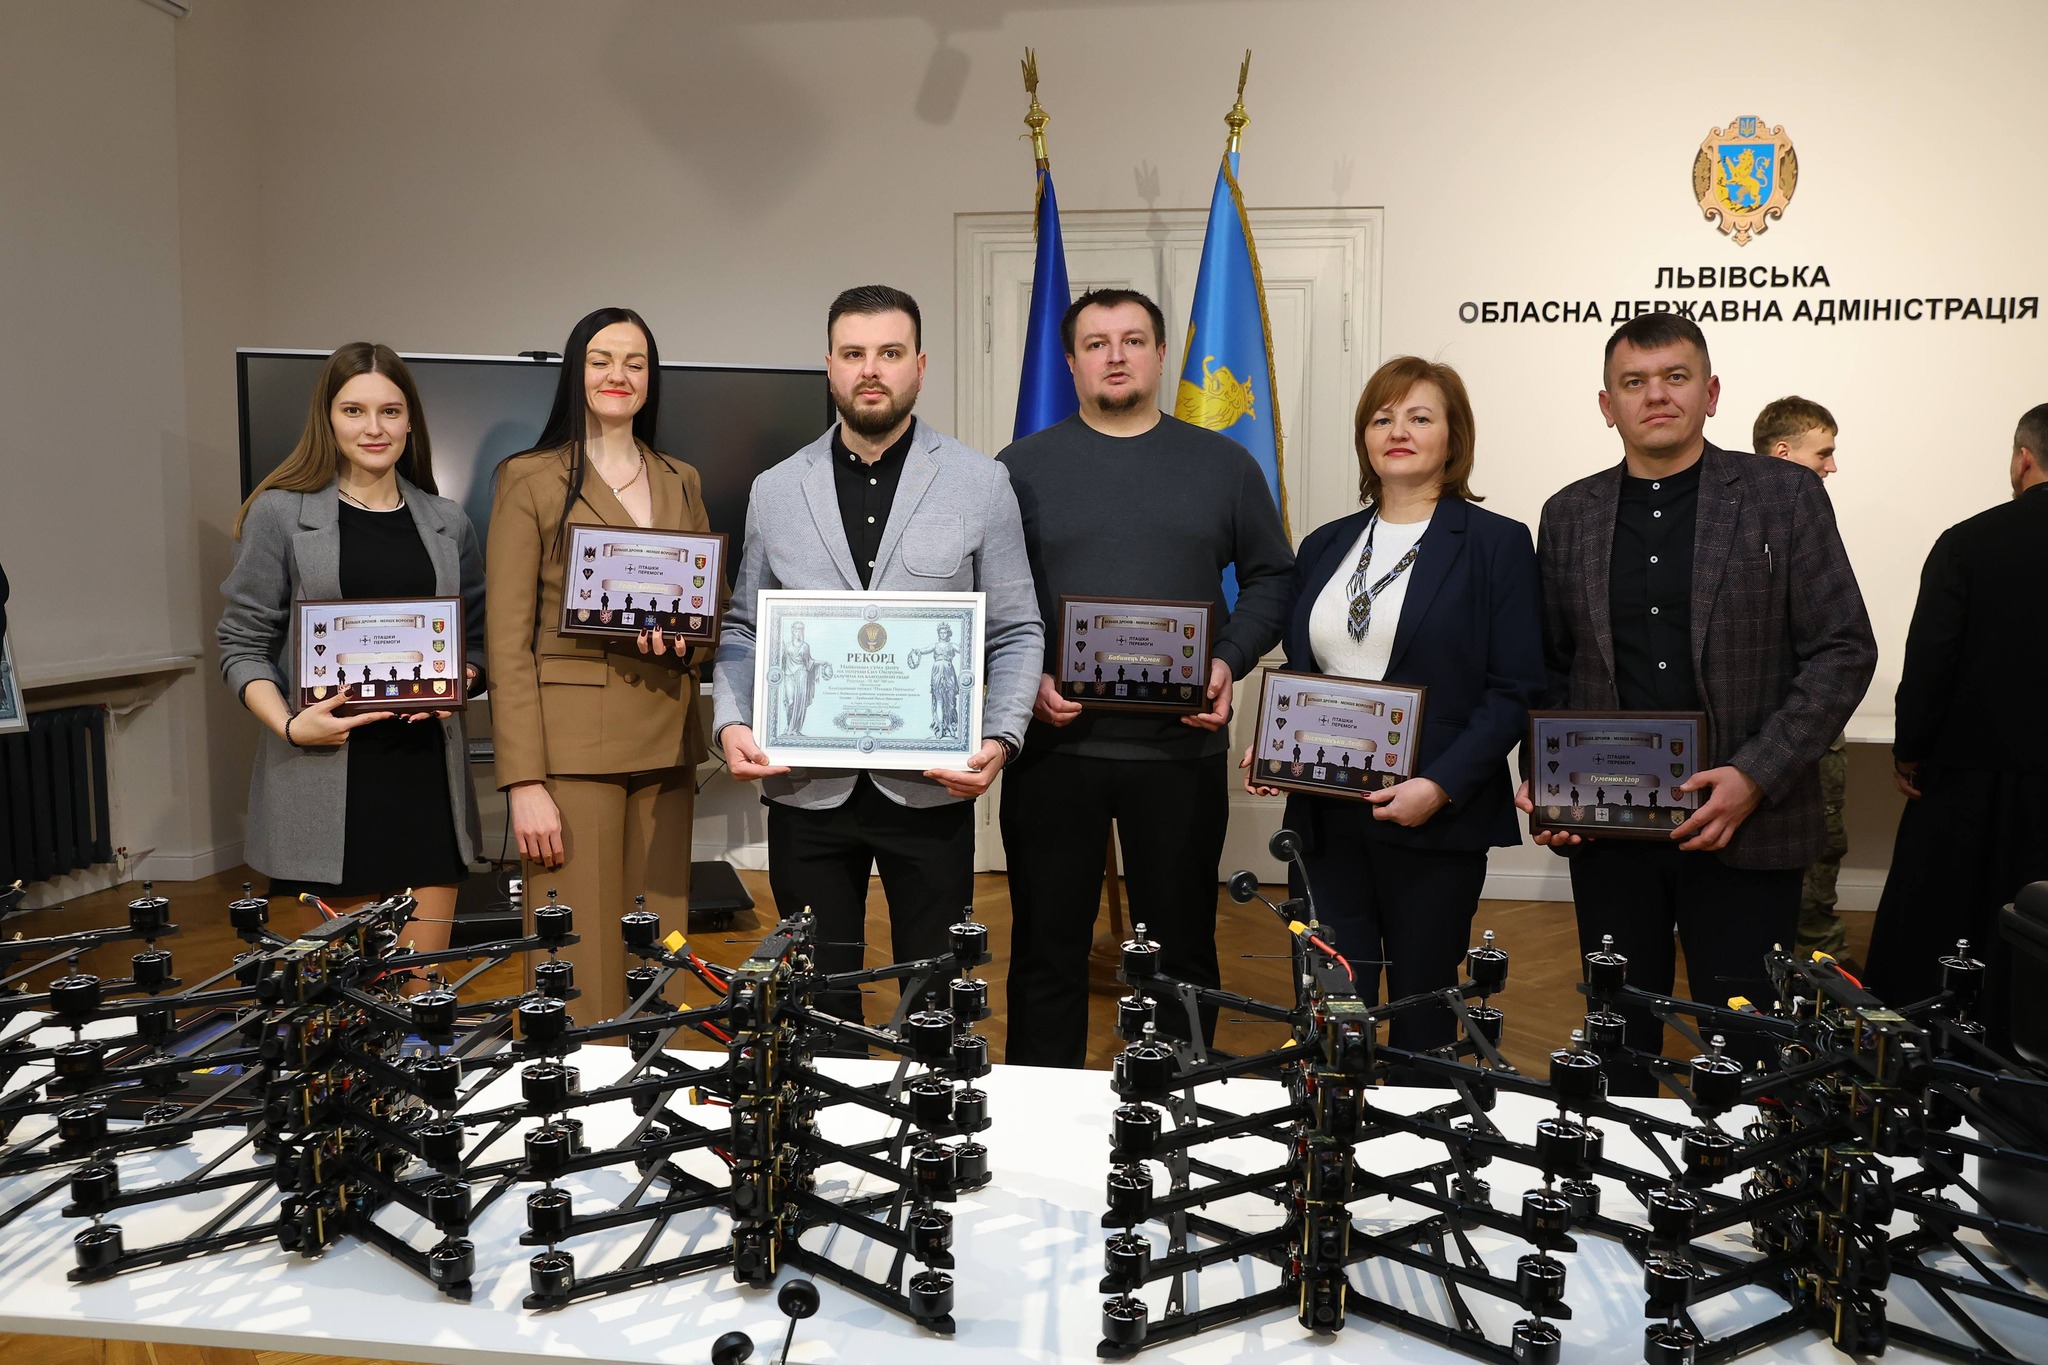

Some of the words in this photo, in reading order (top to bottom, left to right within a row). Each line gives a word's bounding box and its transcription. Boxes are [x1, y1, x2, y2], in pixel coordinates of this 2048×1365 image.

[1655, 265, 1831, 289] ЛЬВІВСЬКА
[1459, 301, 1603, 324] ОБЛАСНА
[1792, 296, 2039, 326] АДМІНІСТРАЦІЯ
[847, 653, 896, 665] РЕКОРД
[1590, 775, 1624, 783] Гуменюк
[1624, 775, 1640, 784] Ігор
